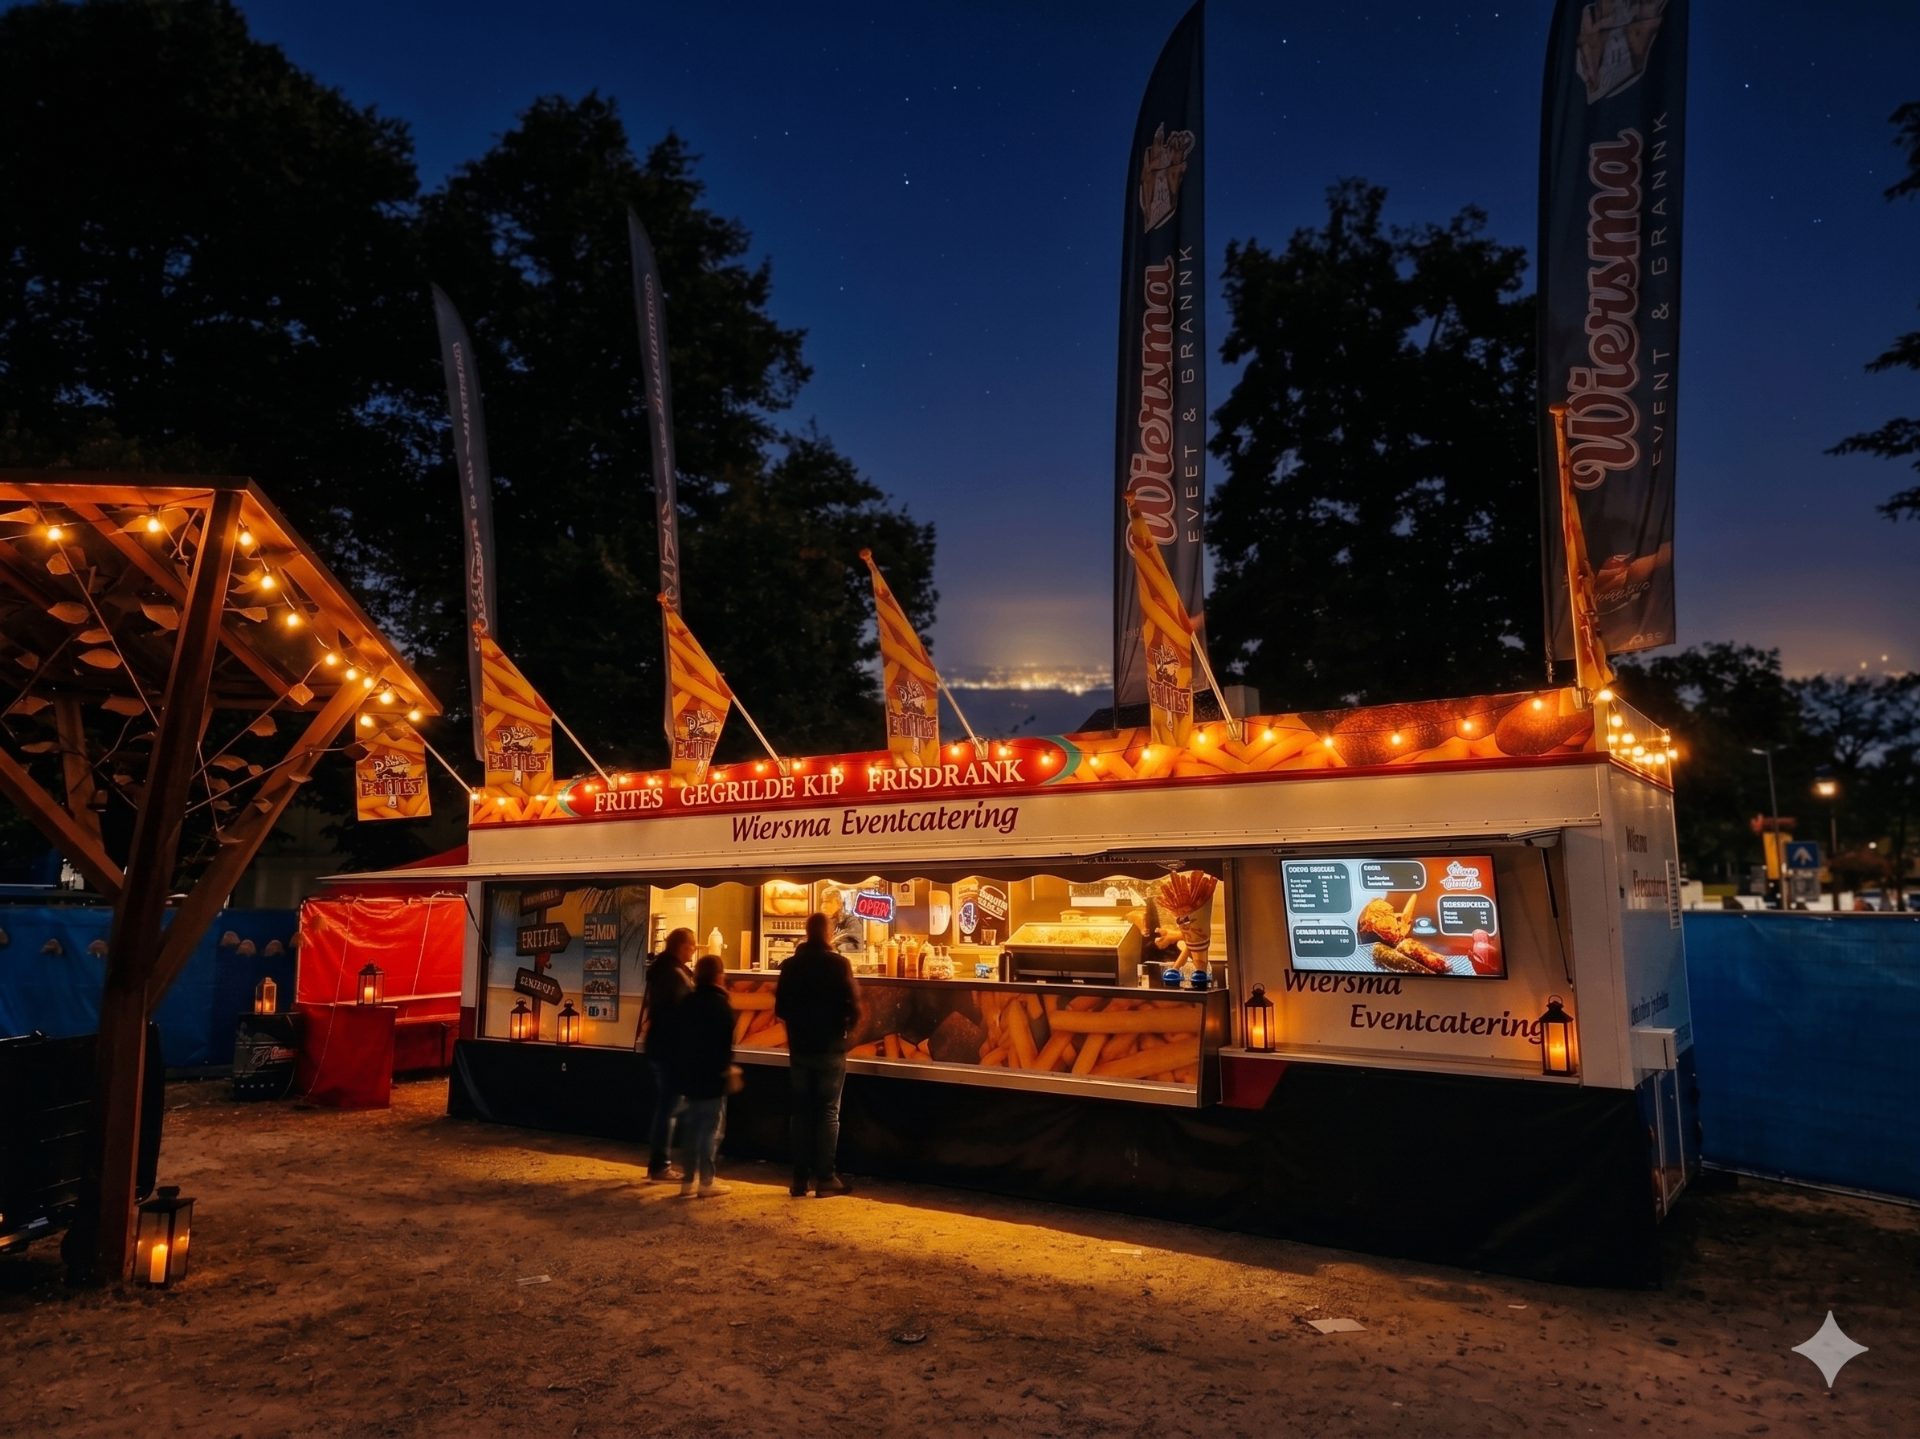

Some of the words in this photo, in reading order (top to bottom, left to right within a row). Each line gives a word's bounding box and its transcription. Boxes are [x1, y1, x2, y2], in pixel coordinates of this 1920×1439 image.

[1651, 111, 1669, 275] GRANNK
[1179, 245, 1194, 384] GRANNK
[1567, 127, 1644, 490] Wiersma
[1651, 302, 1670, 320] &
[1126, 255, 1178, 557] Wiersma
[1182, 407, 1197, 422] &
[1652, 348, 1670, 467] EVENT
[593, 787, 664, 813] FRITES
[680, 776, 796, 807] GEGRILDE
[802, 773, 845, 798] KIP
[866, 758, 1026, 793] FRISDRANK
[732, 815, 831, 843] Wiersma
[841, 801, 1019, 835] Eventcatering
[858, 898, 890, 918] OPEN
[1283, 968, 1403, 996] Wiersma
[1349, 1003, 1544, 1045] Eventcatering
